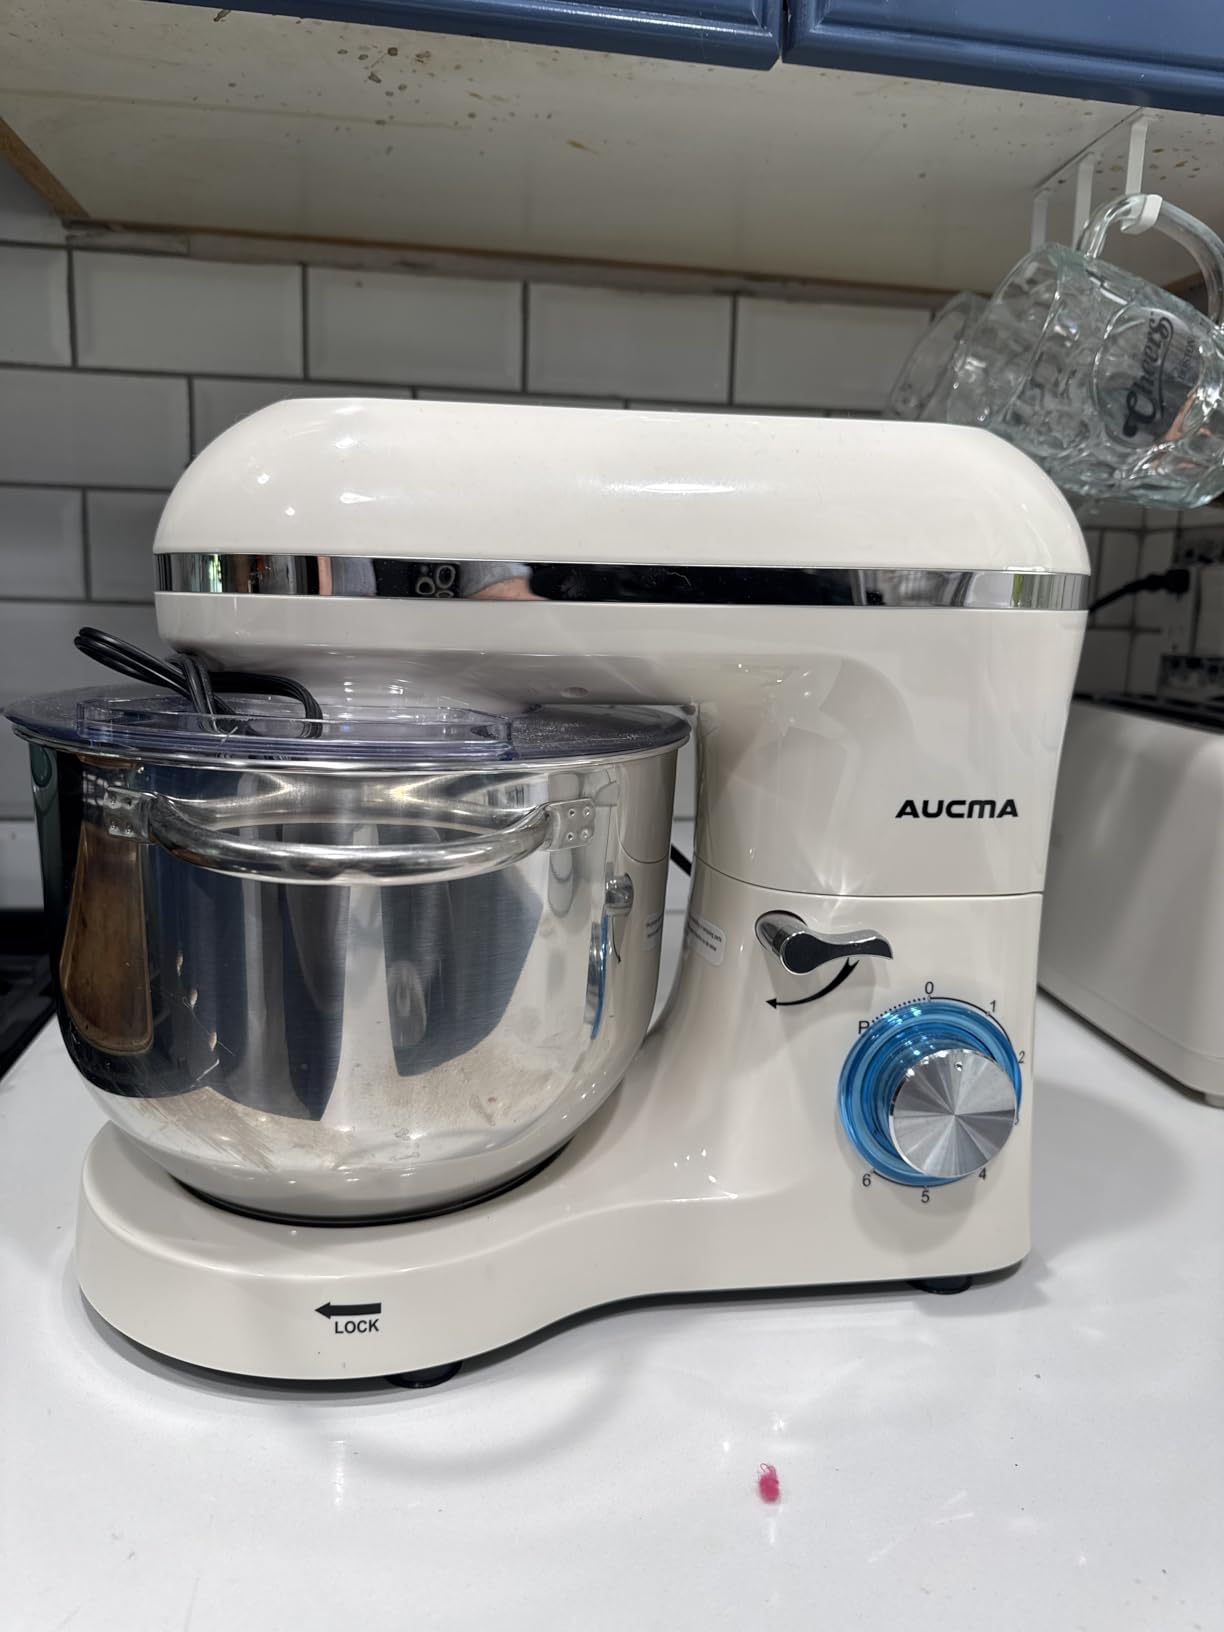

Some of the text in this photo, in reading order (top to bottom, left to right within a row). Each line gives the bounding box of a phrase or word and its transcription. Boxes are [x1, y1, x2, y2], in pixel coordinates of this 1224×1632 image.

[1123, 316, 1174, 437] Cheers
[895, 799, 1018, 818] AUCMA
[924, 981, 934, 995] 0
[990, 999, 997, 1013] 1
[858, 1020, 870, 1034] P
[1018, 1050, 1026, 1064] 2
[862, 1173, 872, 1187] 6
[978, 1167, 987, 1180] 4
[920, 1189, 930, 1203] 5
[334, 1318, 380, 1334] LOCK
